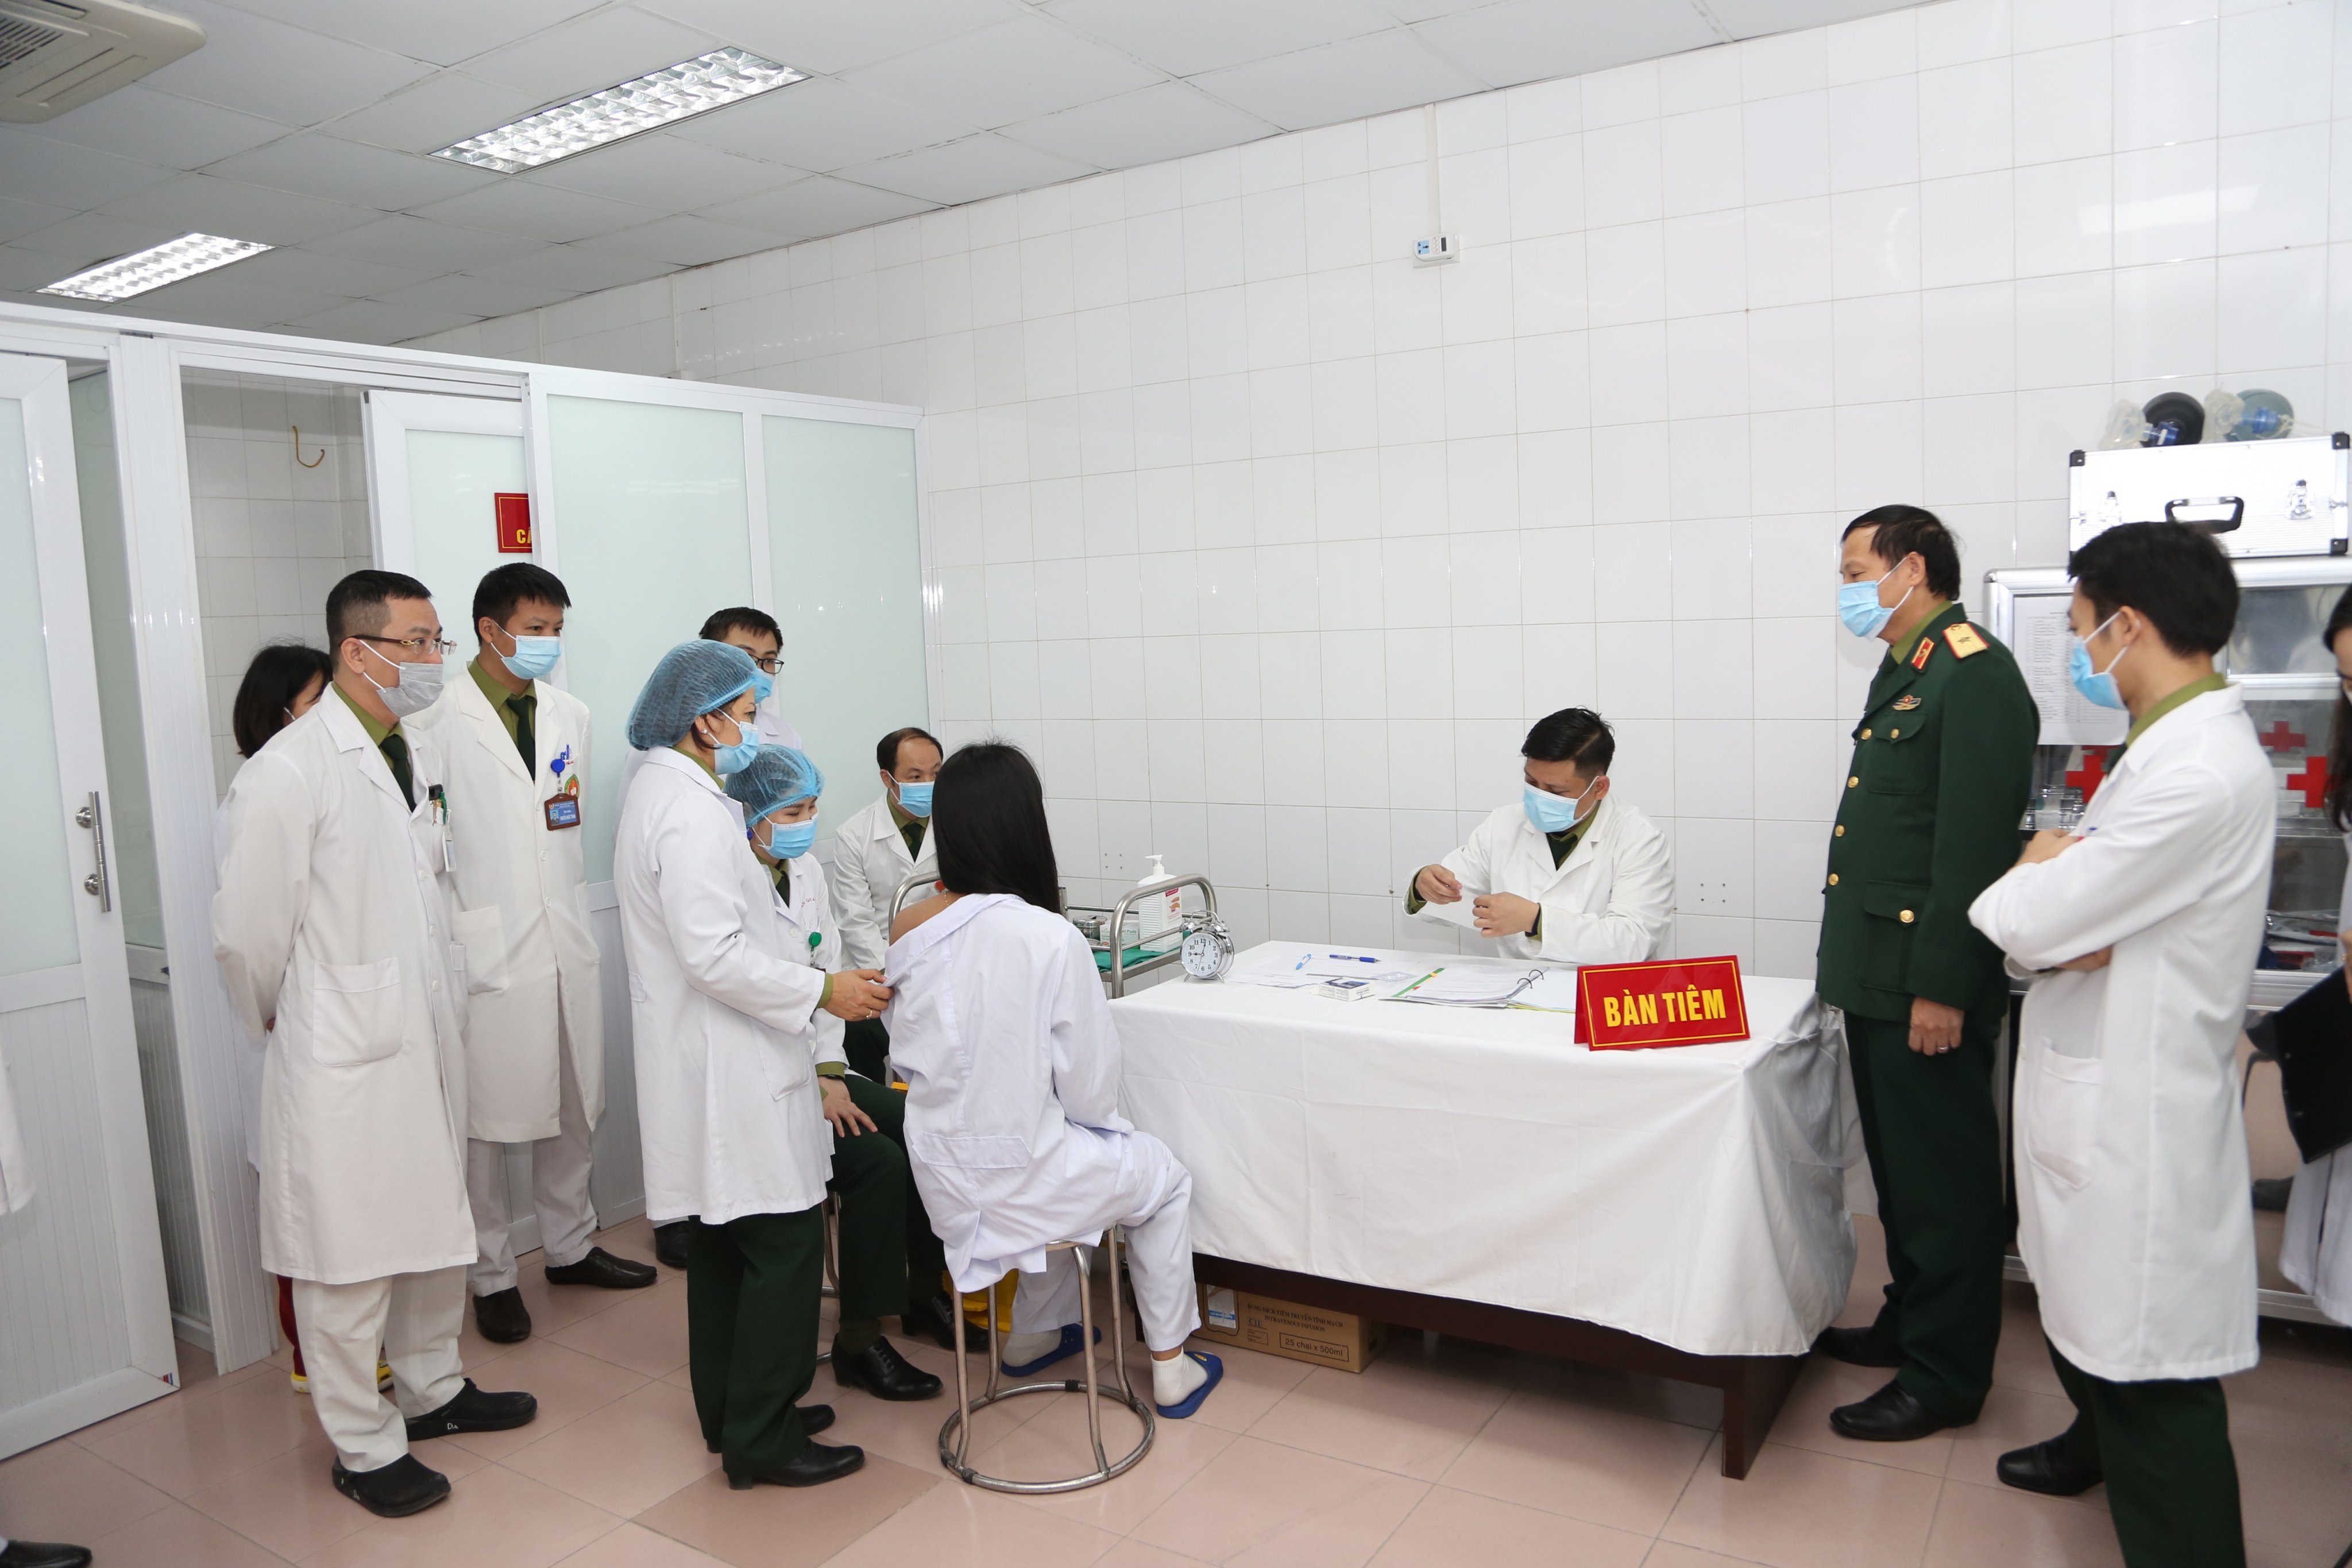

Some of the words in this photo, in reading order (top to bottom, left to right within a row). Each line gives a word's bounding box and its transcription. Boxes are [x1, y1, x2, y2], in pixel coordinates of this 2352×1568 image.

[1604, 988, 1659, 1027] BÀN
[1662, 984, 1727, 1022] TIÊM
[1301, 1323, 1325, 1332] INFUSION
[1296, 1341, 1312, 1350] chai
[1320, 1346, 1343, 1356] 500ml
